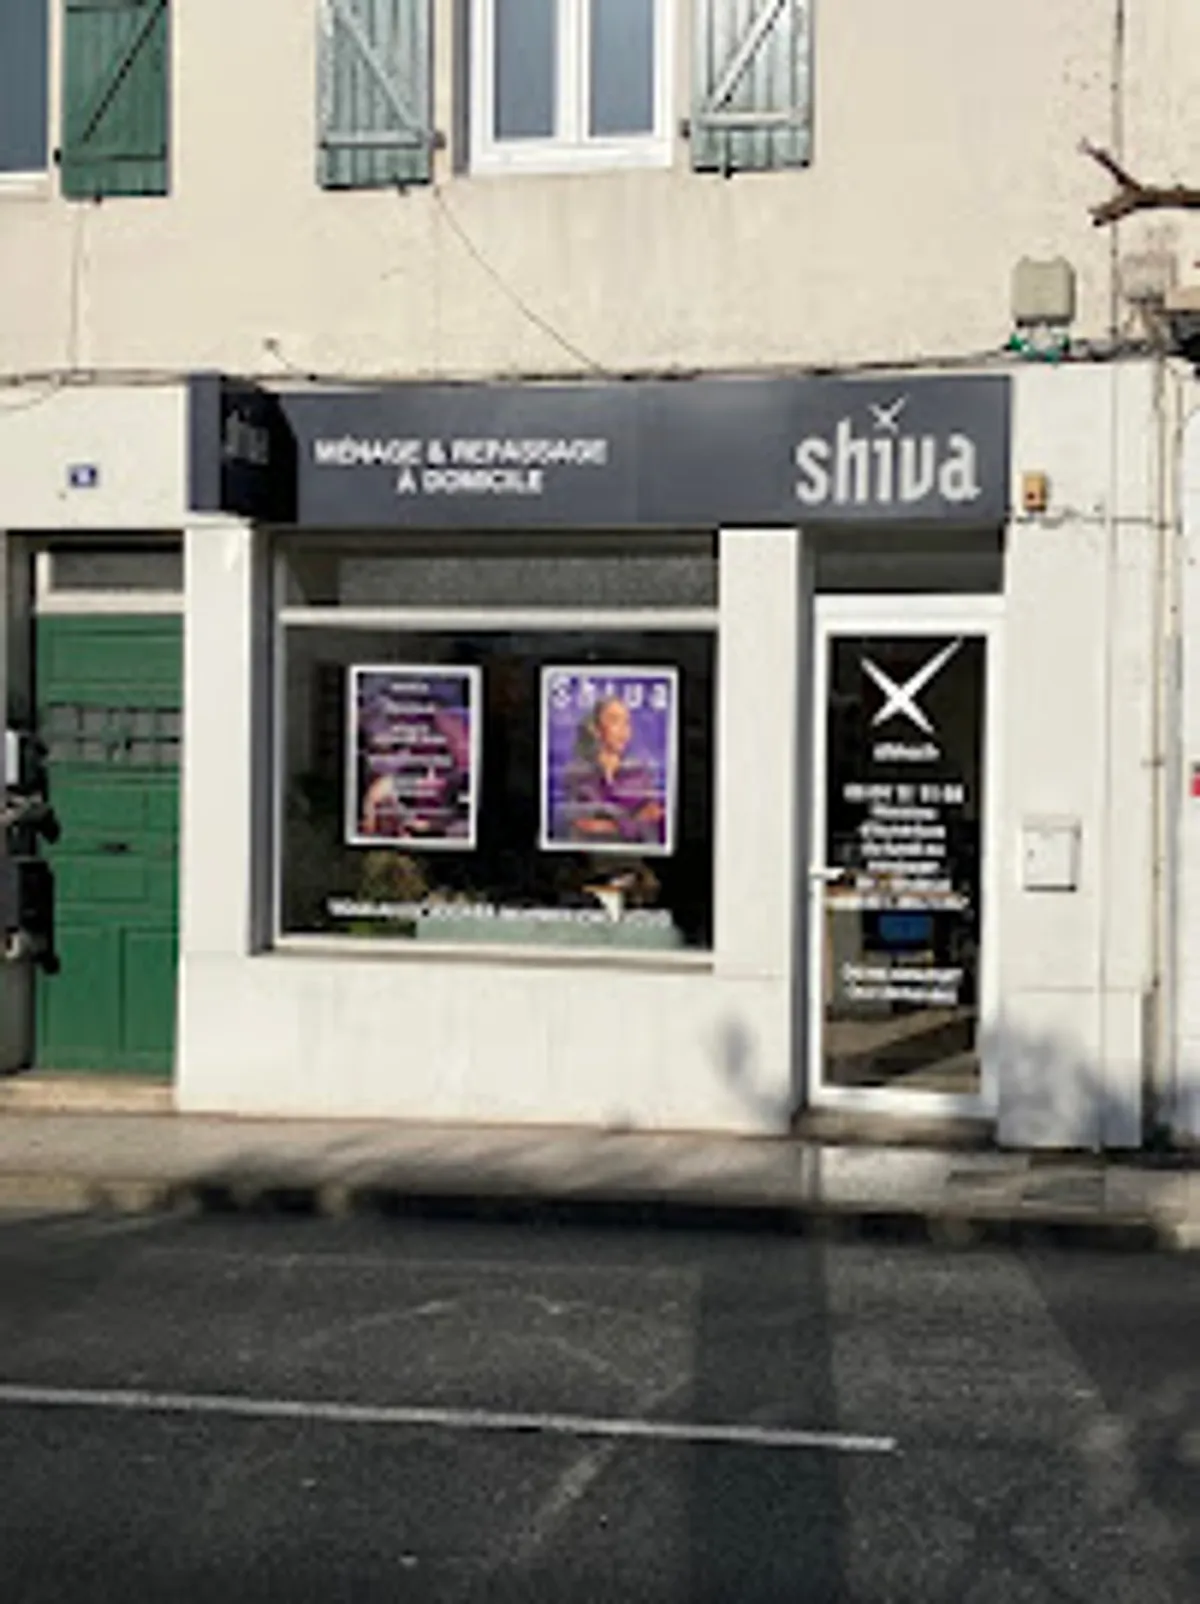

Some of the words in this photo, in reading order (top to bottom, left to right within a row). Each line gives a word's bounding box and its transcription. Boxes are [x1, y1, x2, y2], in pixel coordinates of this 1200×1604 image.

[313, 434, 423, 466] MÉNAGE
[427, 440, 447, 465] &
[451, 438, 609, 467] REPASSAGE
[796, 397, 982, 506] shiva
[421, 468, 544, 495] DOMICILE
